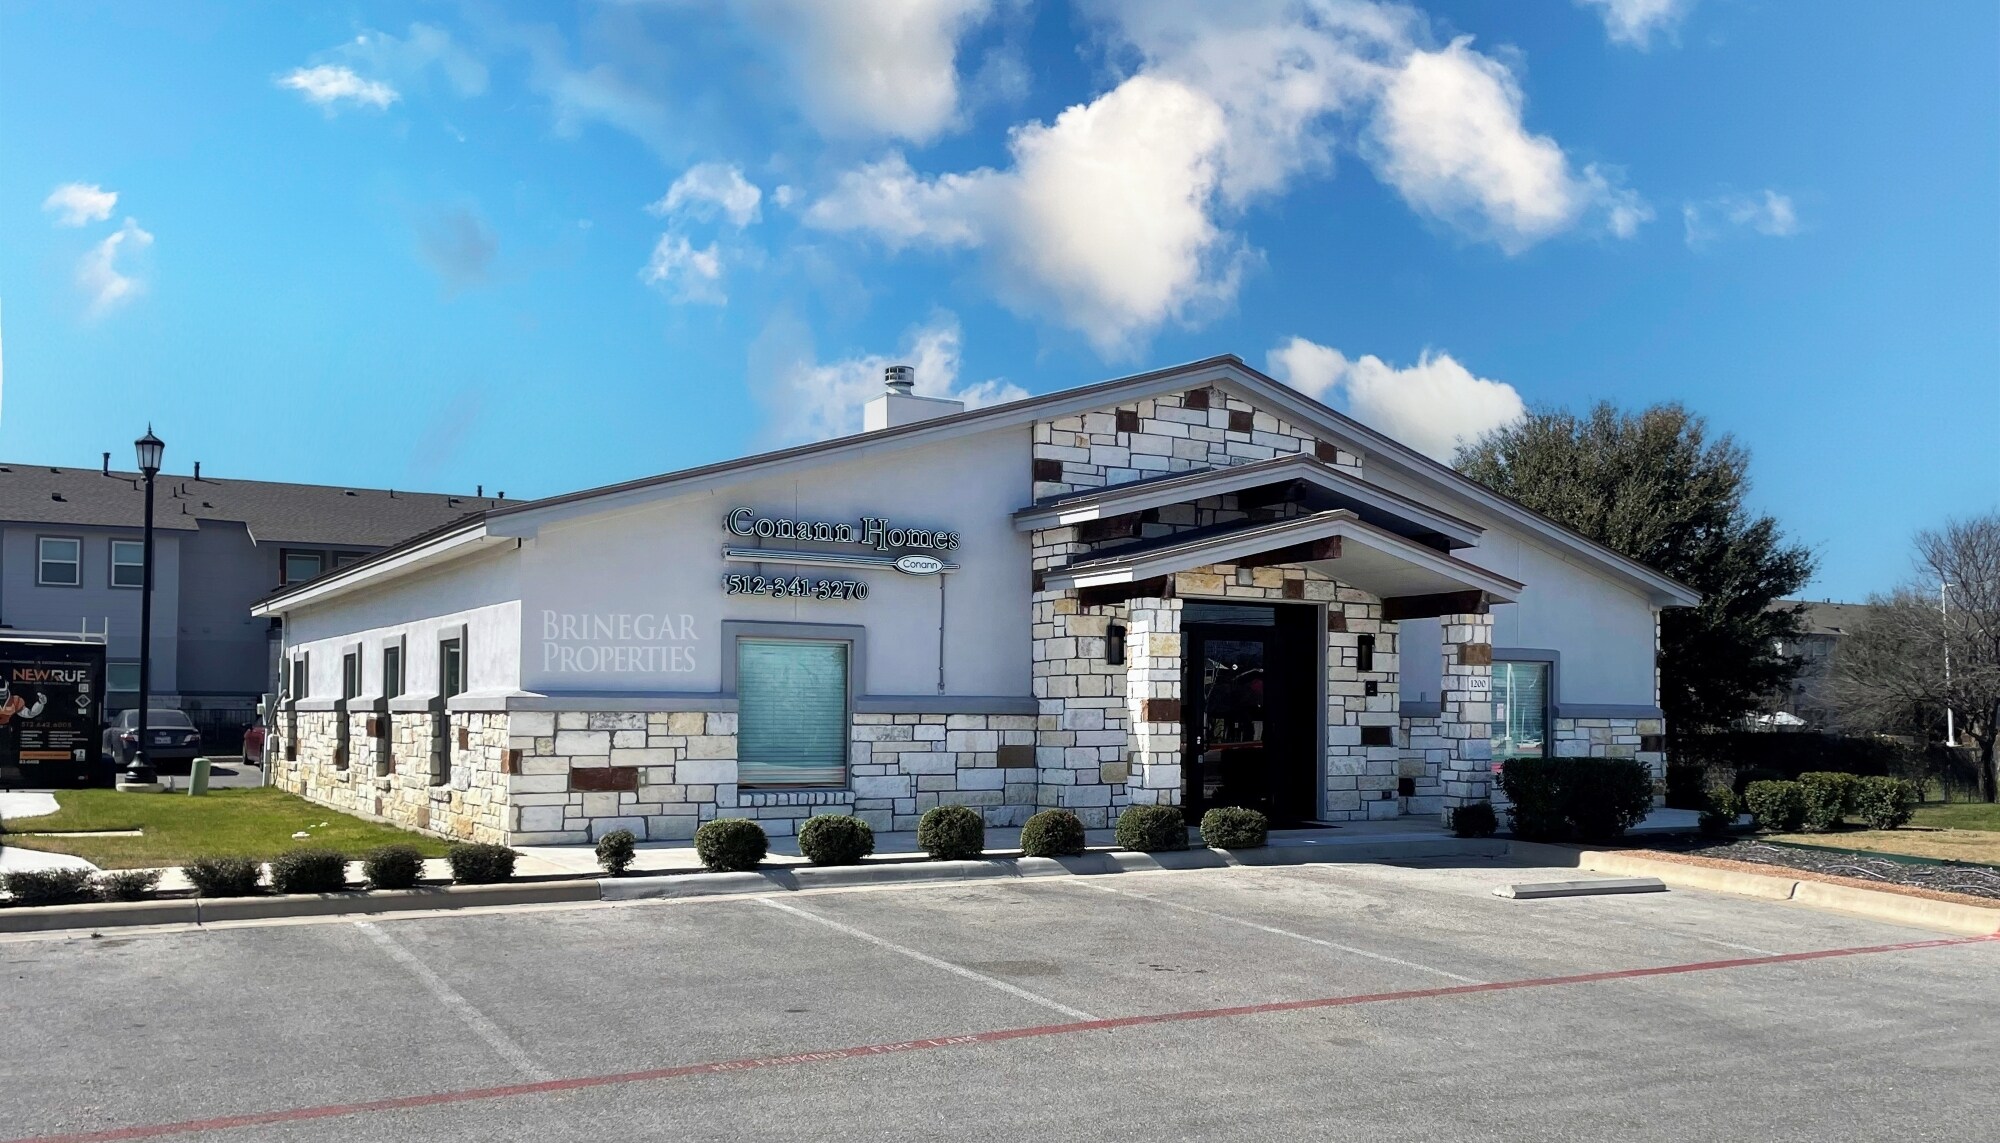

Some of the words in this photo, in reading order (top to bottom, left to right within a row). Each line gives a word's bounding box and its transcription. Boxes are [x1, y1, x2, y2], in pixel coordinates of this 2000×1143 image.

[727, 507, 855, 543] Conann
[860, 517, 961, 551] Homes
[902, 559, 938, 570] Conann
[727, 574, 869, 601] 512-341-3270
[1470, 679, 1486, 688] 1200
